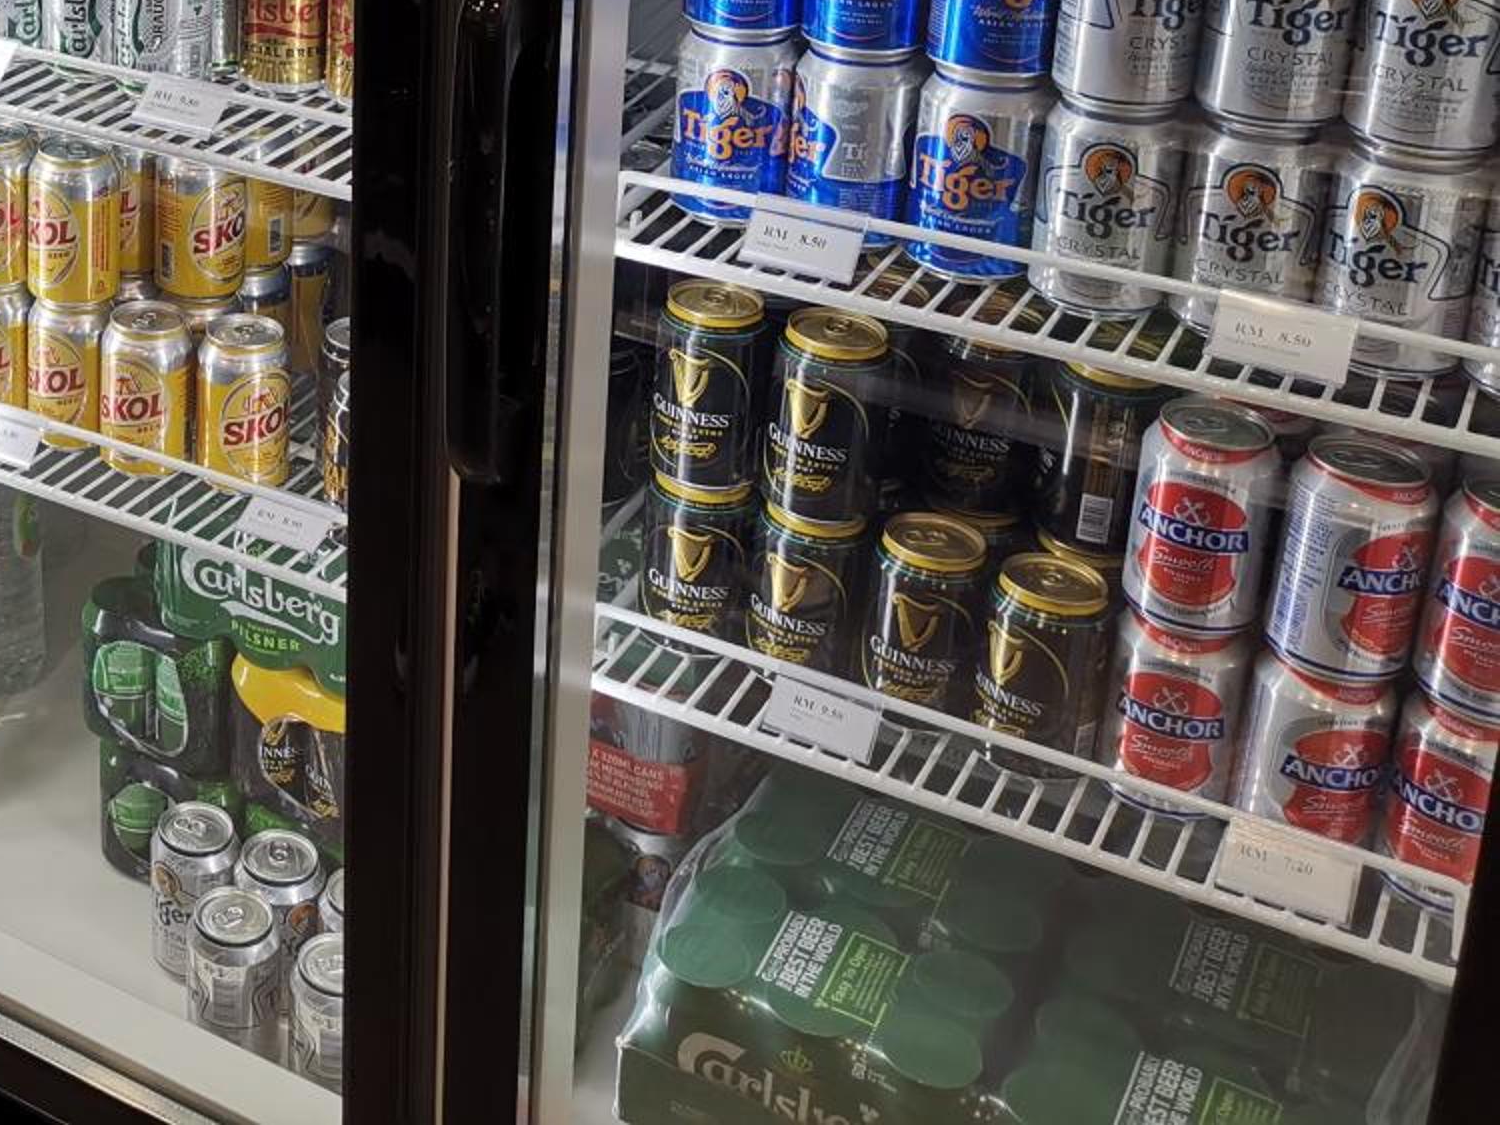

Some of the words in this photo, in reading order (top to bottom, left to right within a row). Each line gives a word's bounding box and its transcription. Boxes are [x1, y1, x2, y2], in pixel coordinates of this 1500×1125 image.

[1376, 9, 1490, 68] Tiger
[1371, 62, 1468, 93] CRYSTAL
[680, 109, 770, 160] Tiger
[919, 152, 1013, 210] Tiger
[29, 214, 77, 246] KOL
[192, 206, 245, 256] SKO
[763, 224, 789, 242] RM
[1059, 191, 1157, 240] Tiger
[1200, 211, 1300, 262] Tiger
[1056, 235, 1140, 261] CRYSTAL
[1329, 231, 1429, 286] Tiger
[1195, 256, 1284, 286] CRYSTAL
[1233, 321, 1264, 338] RM
[101, 389, 166, 423] SKOL
[223, 400, 291, 448] SKOL
[653, 392, 730, 428] GUINNESS
[769, 420, 849, 464] GUINNESS
[1138, 505, 1247, 552] ANCHOR
[1151, 544, 1216, 574] Smooth
[178, 544, 340, 647] Carlsberg
[649, 567, 730, 603] GUINNESS
[228, 618, 299, 651] PILSNER
[750, 593, 829, 637] GUINNESS
[869, 633, 958, 675] GUINNESS
[1117, 696, 1222, 740] ANCHOR
[1285, 756, 1380, 789] ANCHO
[1238, 845, 1268, 863] RM
[779, 947, 810, 985] BEST
[798, 916, 829, 951] BEER
[812, 924, 844, 964] WORLD
